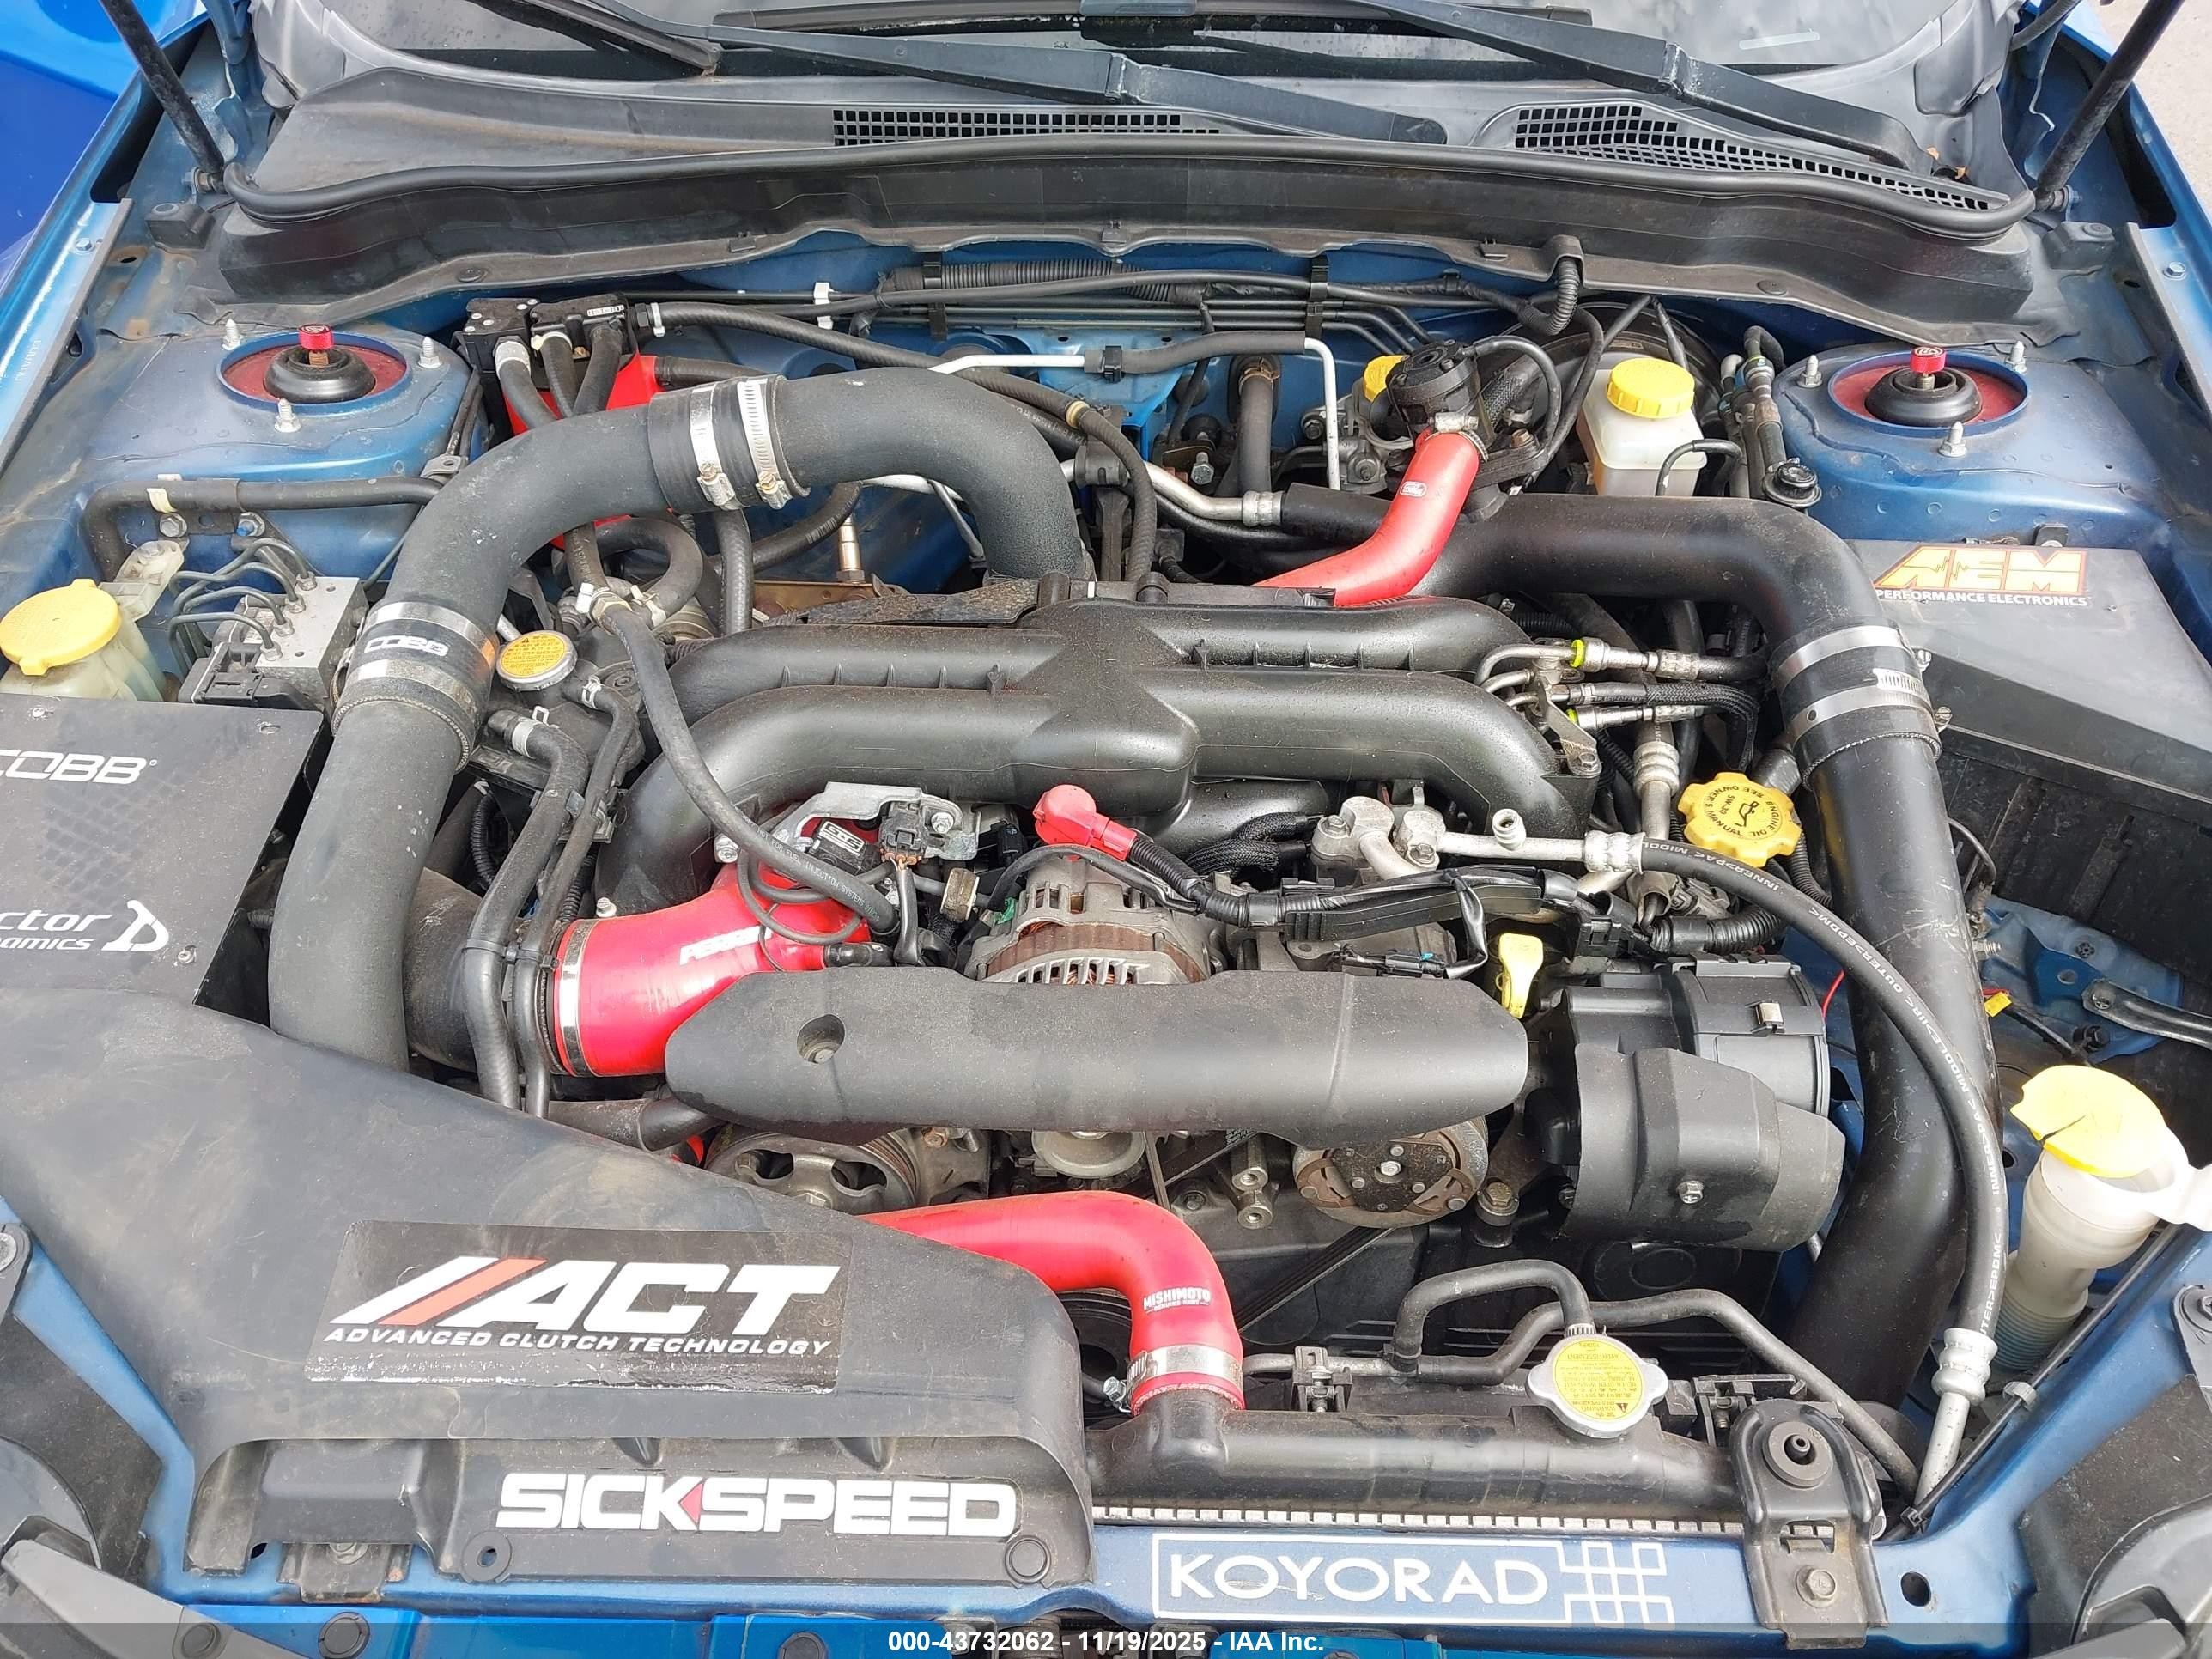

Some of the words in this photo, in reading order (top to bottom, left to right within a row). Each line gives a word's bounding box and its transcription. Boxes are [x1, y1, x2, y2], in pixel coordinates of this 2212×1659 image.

[1874, 545, 2087, 595] AEM
[1875, 588, 1985, 604] PERFORMANCE
[1988, 593, 2087, 606] ELECTRONICS
[364, 635, 449, 656] COBB
[1743, 786, 1765, 799] SEE
[1705, 810, 1744, 836] MANUAL
[1765, 800, 1779, 832] ENGINE
[1749, 829, 1768, 837] OIL
[771, 840, 784, 852] FOR
[786, 849, 801, 865] FUEL
[805, 860, 839, 888] INJECTION
[839, 884, 865, 907] SYSTEMS
[437, 1260, 841, 1336] ACT
[1143, 1287, 1211, 1311] MISHIMOTO
[323, 1328, 491, 1347] ADVANCED
[499, 1332, 621, 1352] CLUTCH
[628, 1337, 832, 1356] TECHNOLOGY
[495, 1473, 1018, 1537] SICKSPEED
[1170, 1554, 1549, 1605] KOYORAD
